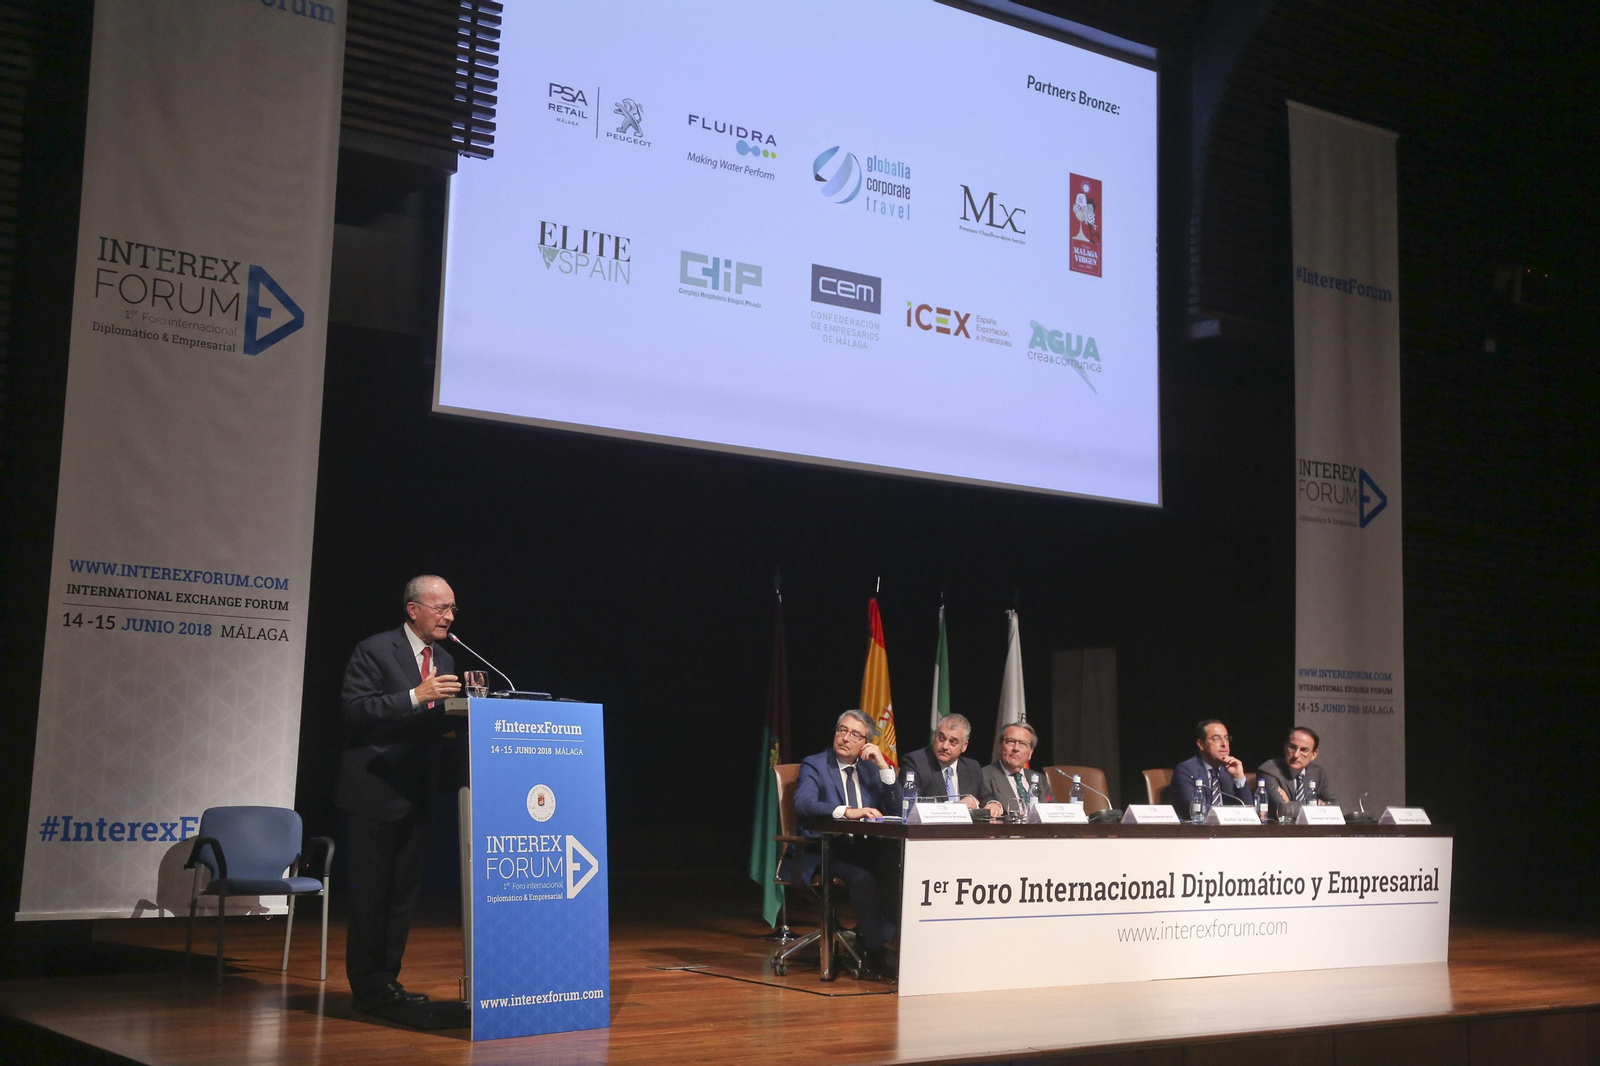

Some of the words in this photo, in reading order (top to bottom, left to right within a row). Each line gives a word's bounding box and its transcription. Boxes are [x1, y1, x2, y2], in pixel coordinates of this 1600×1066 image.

[548, 82, 589, 107] PSA
[1027, 74, 1077, 103] Partners
[1078, 90, 1120, 116] Bronze:
[548, 102, 588, 119] RETAIL
[606, 131, 653, 148] PEUGEOT
[688, 113, 778, 147] FLUIDRA
[687, 152, 718, 170] Making
[719, 159, 744, 173] Water
[743, 165, 776, 181] Perform
[867, 154, 912, 180] globalia
[866, 177, 912, 200] corporate
[866, 195, 911, 221] travel
[537, 219, 632, 263] ELITE
[97, 236, 241, 285] INTEREX
[558, 250, 631, 286] SPAIN
[95, 267, 241, 322] FORUM
[818, 275, 875, 303] cem
[1296, 264, 1392, 301] #InterexForum
[142, 312, 167, 326] Foro
[168, 315, 238, 337] internacional
[810, 310, 881, 331] CONFEDERACIÓN
[811, 321, 822, 331] DE
[823, 323, 880, 342] EMPRESARIOS
[976, 315, 998, 326] España
[976, 325, 1010, 338] Exportación
[92, 321, 160, 341] Diplomático
[161, 333, 170, 343] &
[171, 334, 236, 353] Empresarial
[822, 333, 834, 344] DE
[835, 336, 868, 350] MÁLAGA
[981, 335, 1013, 348] Inversiones
[1028, 326, 1101, 362] AGUA
[1299, 458, 1357, 483] INTEREX
[1298, 479, 1358, 506] FORUM
[69, 558, 290, 591] WWW.INTEREXFORUM.COM
[66, 583, 173, 603] INTERNATIONAL
[175, 592, 242, 608] EXCHANGE
[244, 598, 289, 611] FORUM
[121, 617, 175, 635] JUNIO
[178, 621, 213, 637] 2018
[220, 623, 290, 642] MÁLAGA
[1298, 668, 1392, 681] WWW.INTEREXFORUM.COM
[1298, 684, 1344, 693] INTERNATIONAL
[1344, 686, 1370, 694] EXCHANGE
[1370, 687, 1393, 695] FORUM
[1321, 704, 1347, 714] JUNIO
[1362, 705, 1395, 715] MÁLAGA
[494, 719, 583, 735] #InterexForum
[514, 746, 537, 755] JUNIO
[537, 747, 552, 755] 2018
[554, 746, 584, 756] MÁLAGA
[486, 835, 563, 853] INTEREX
[486, 856, 563, 880] FORUM
[486, 894, 523, 904] Diplomático
[528, 892, 564, 902] Empresarial
[512, 882, 526, 890] Foro
[526, 881, 563, 890] internacional
[955, 878, 1013, 906] Foro
[1018, 872, 1176, 904] Internacional
[1181, 870, 1306, 904] Diplomático
[1310, 877, 1323, 901] y
[1327, 868, 1440, 899] Empresarial
[1117, 918, 1289, 943] www.interexforum.com
[480, 989, 604, 1009] www.interexforum.com
